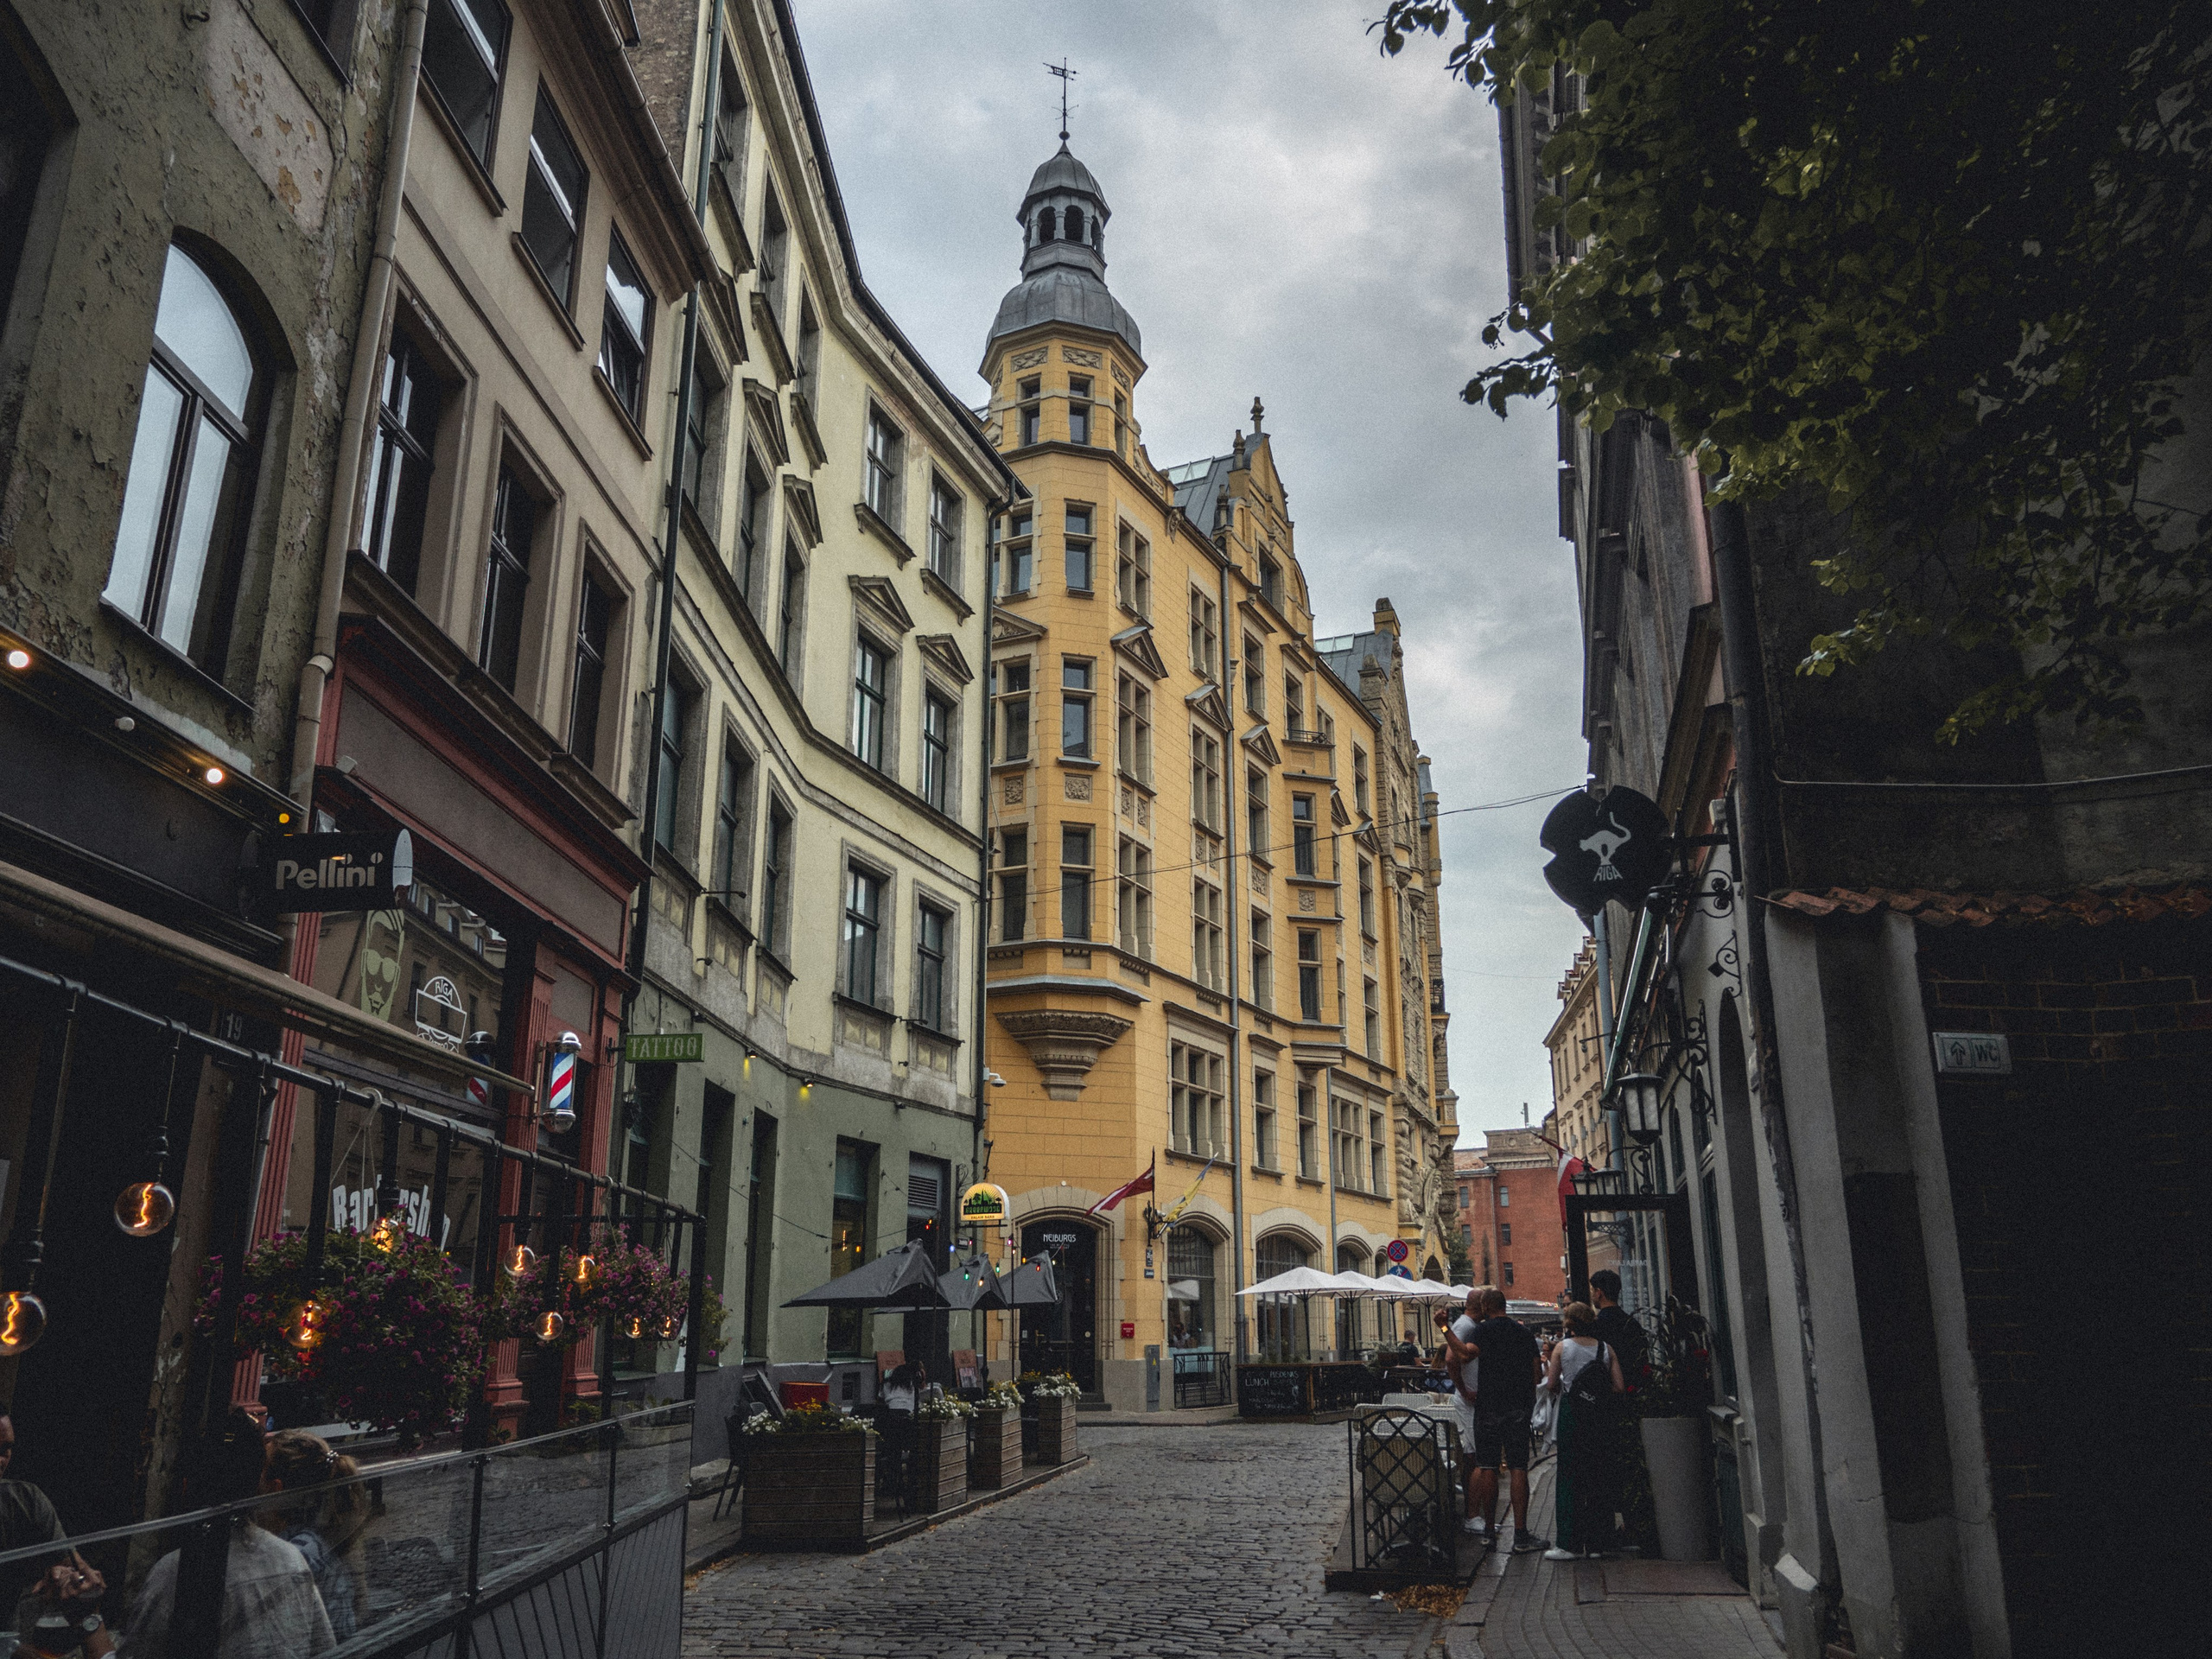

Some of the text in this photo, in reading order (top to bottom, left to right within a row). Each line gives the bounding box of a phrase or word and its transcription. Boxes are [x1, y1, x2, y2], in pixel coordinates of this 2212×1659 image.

[276, 852, 383, 890] Pellini
[1593, 866, 1623, 881] RIGA
[226, 1012, 243, 1040] 19
[630, 1037, 697, 1058] TATTOO
[1976, 1045, 1998, 1062] WC
[1043, 1233, 1077, 1243] NEIBURGS
